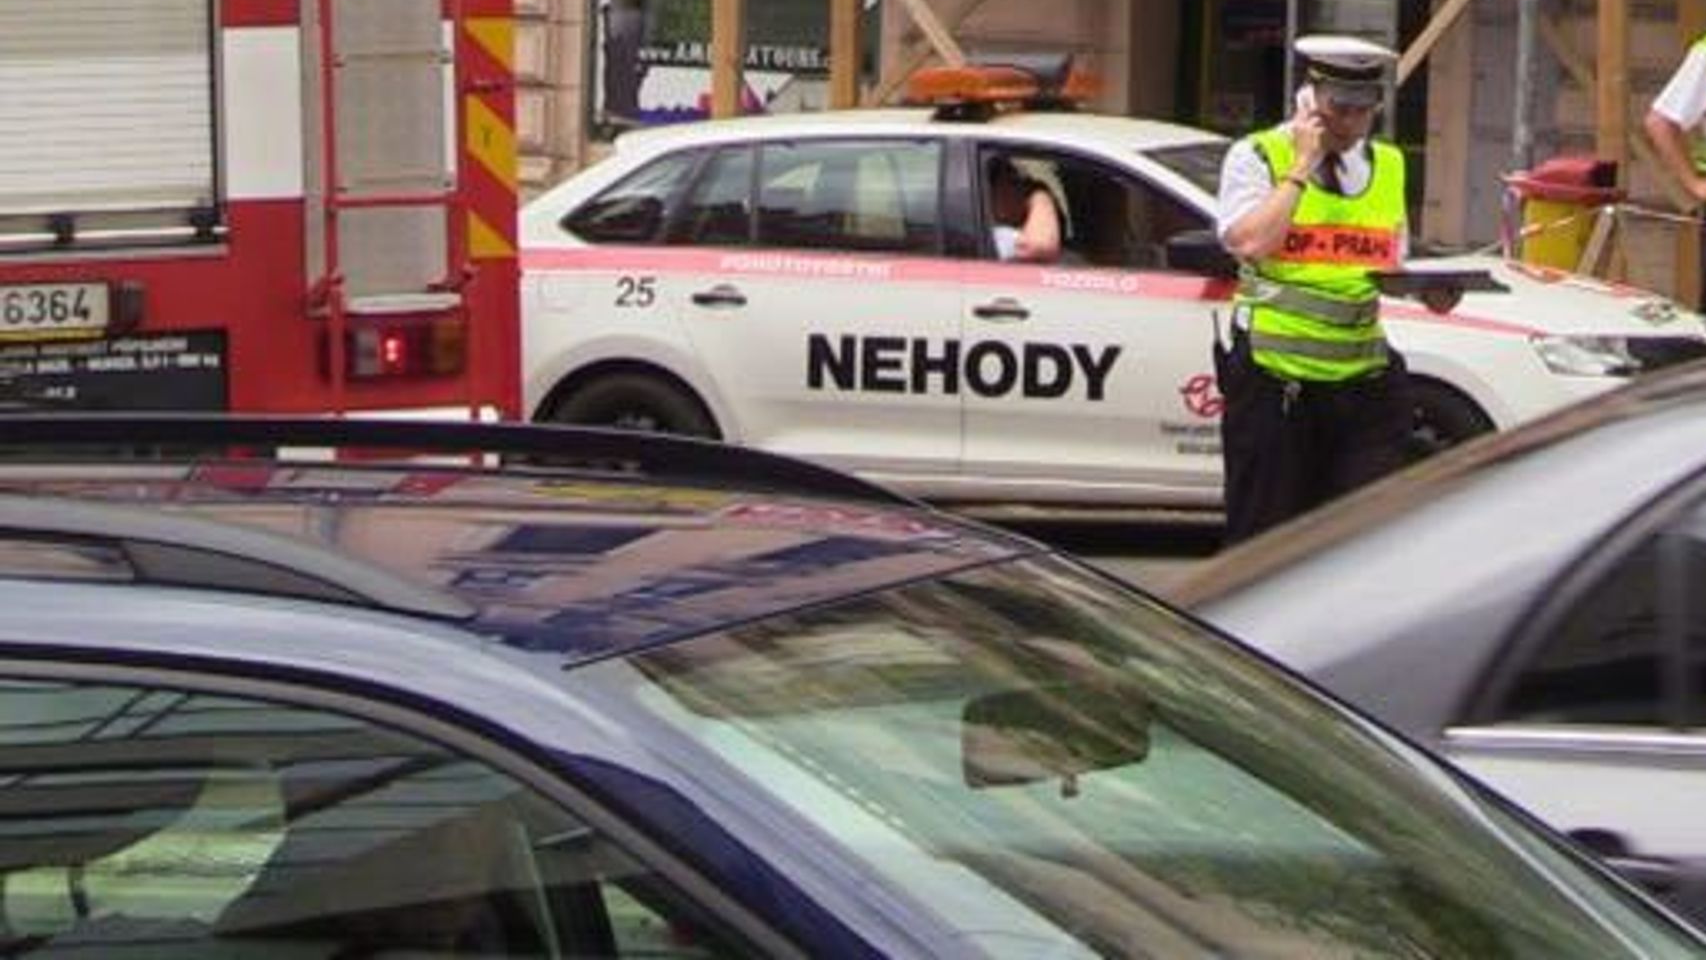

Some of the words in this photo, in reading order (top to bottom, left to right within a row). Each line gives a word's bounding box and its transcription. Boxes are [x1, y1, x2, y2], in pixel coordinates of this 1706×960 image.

[3, 290, 91, 324] 6364
[615, 276, 656, 308] 25
[806, 333, 1122, 401] NEHODY
